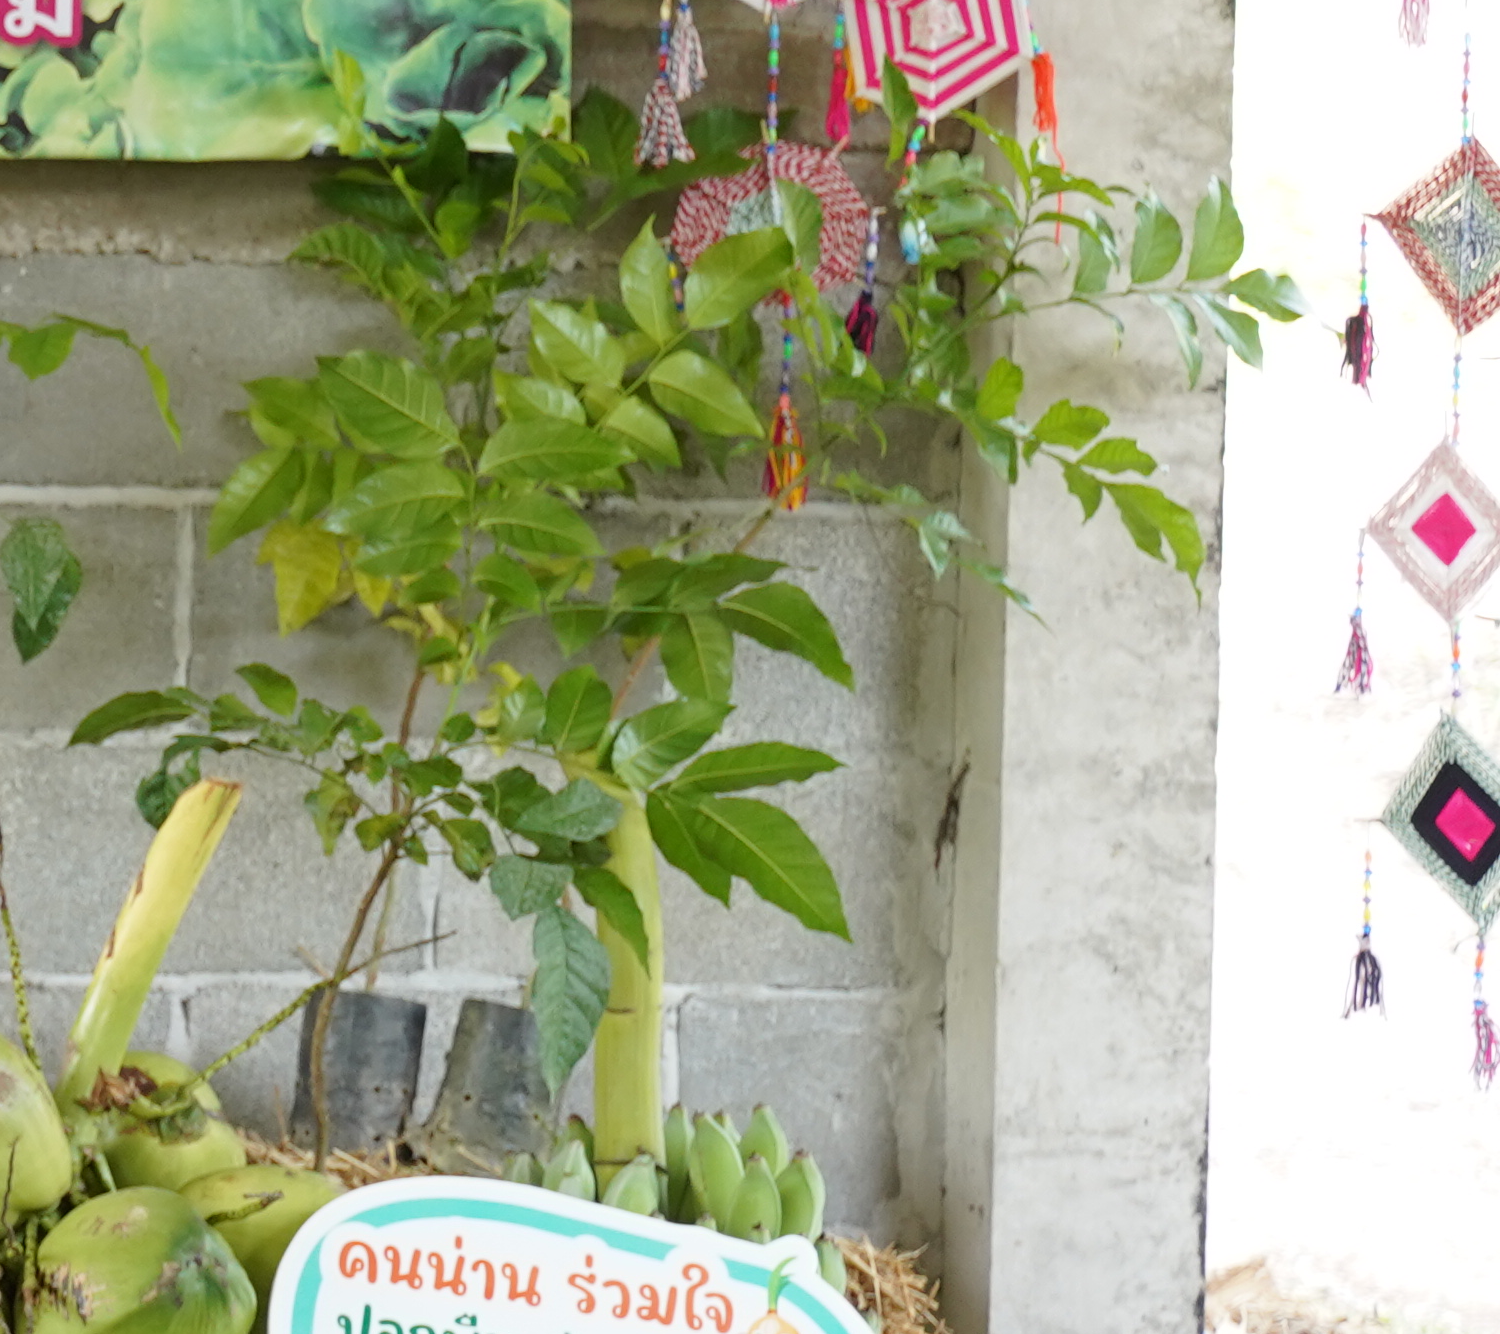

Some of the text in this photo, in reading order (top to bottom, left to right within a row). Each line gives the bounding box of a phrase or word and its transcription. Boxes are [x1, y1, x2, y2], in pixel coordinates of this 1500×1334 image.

[336, 1233, 736, 1334] คนน่าน ร่วมใจ
